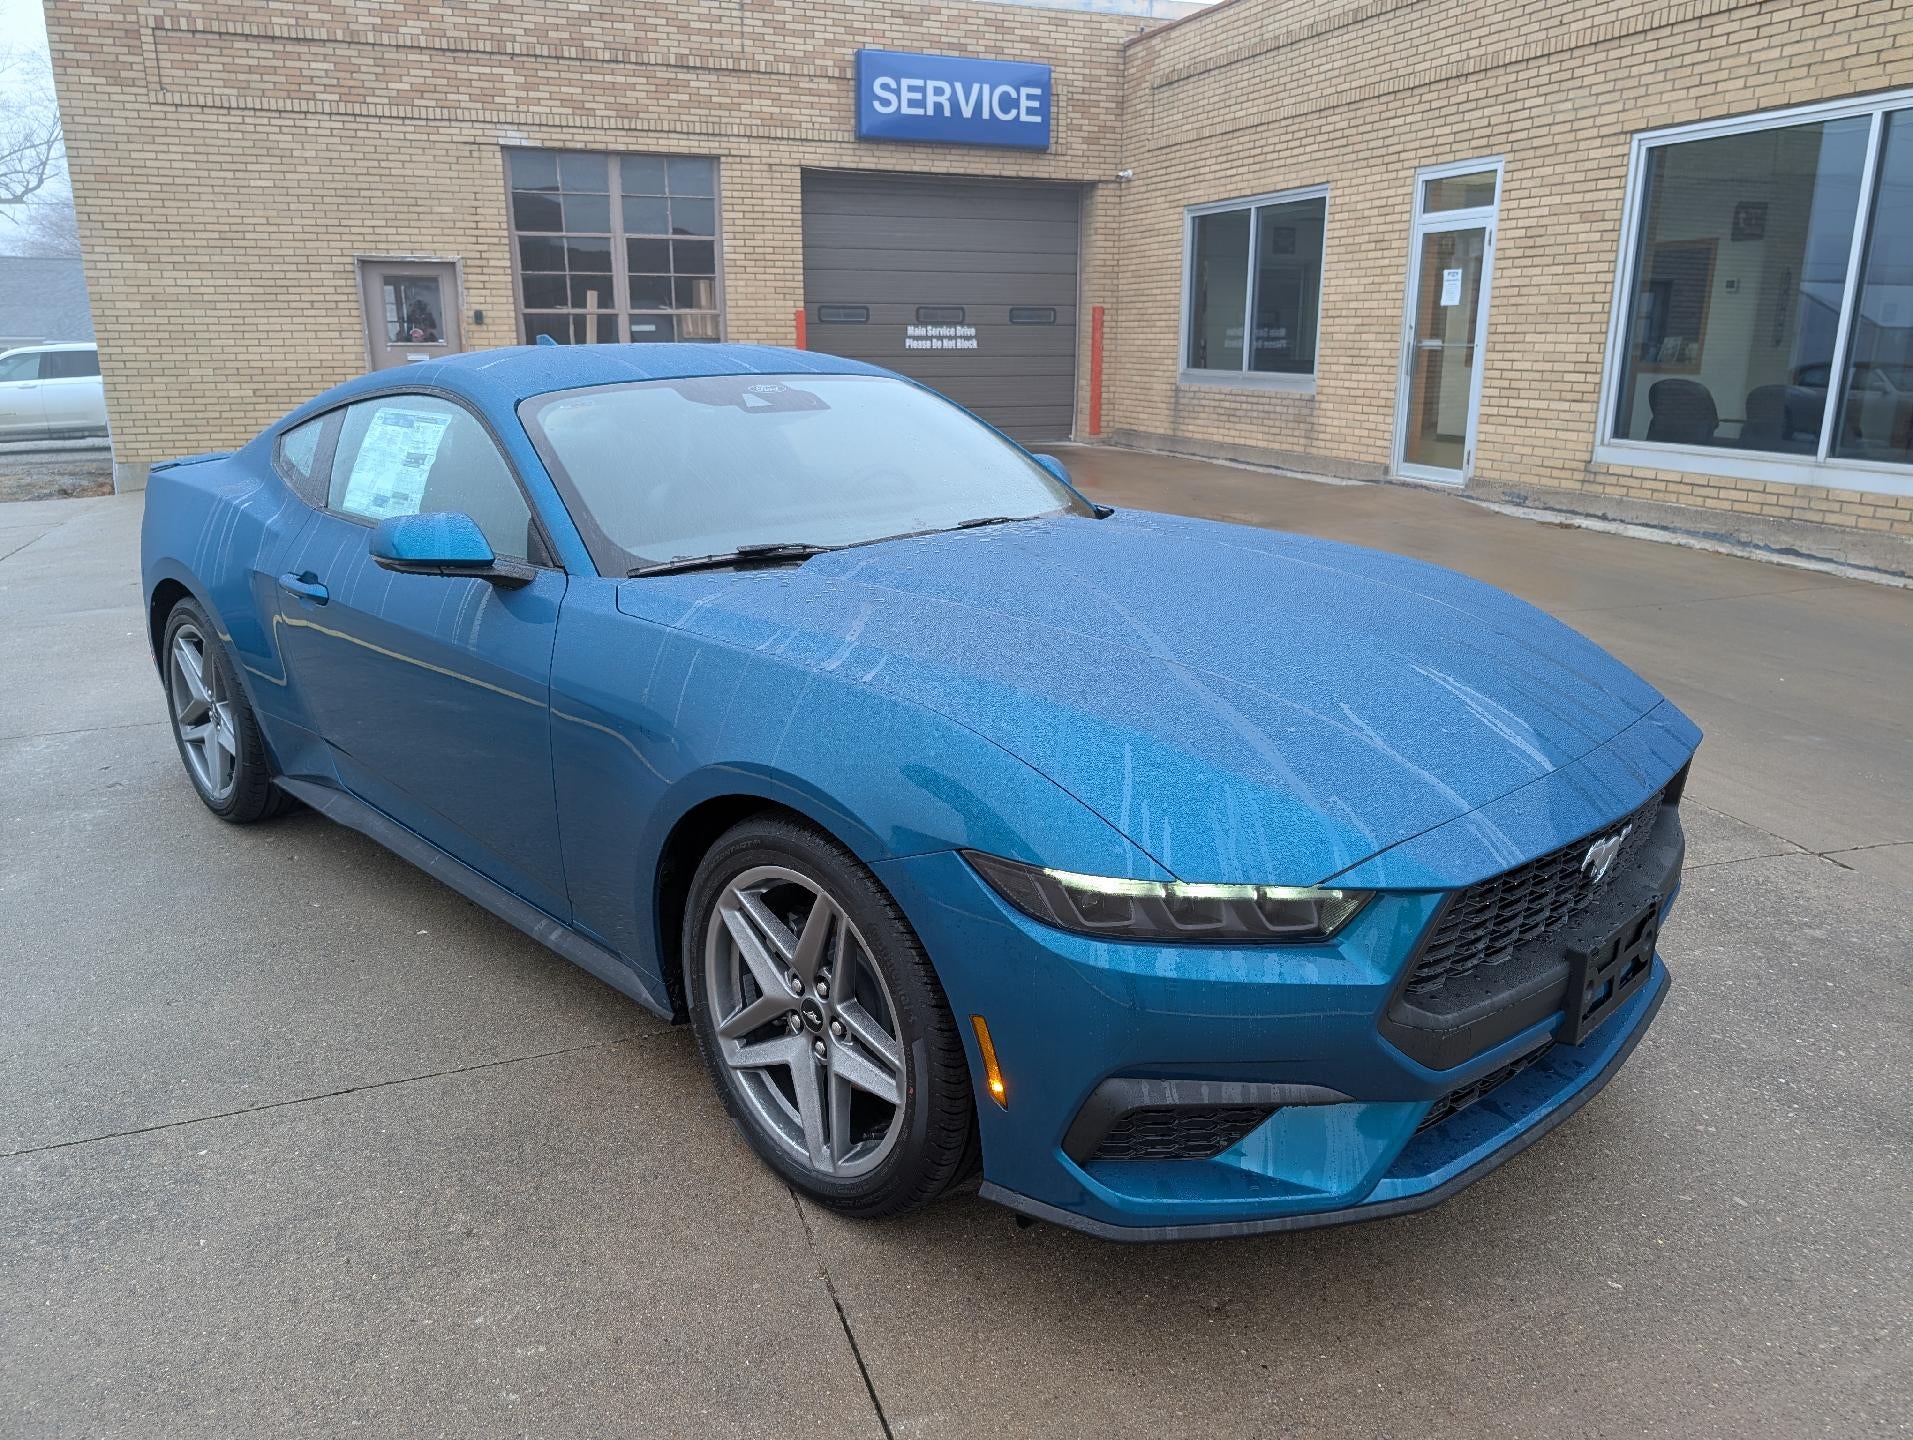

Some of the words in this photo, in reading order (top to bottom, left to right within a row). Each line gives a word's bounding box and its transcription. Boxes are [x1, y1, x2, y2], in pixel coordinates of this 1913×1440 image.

[872, 76, 1042, 123] SERVICE
[907, 325, 926, 336] Main
[927, 325, 955, 336] Service
[956, 325, 976, 336] Drive
[905, 338, 931, 349] Please
[932, 338, 942, 349] Do
[943, 338, 956, 349] Not
[956, 338, 978, 349] Block
